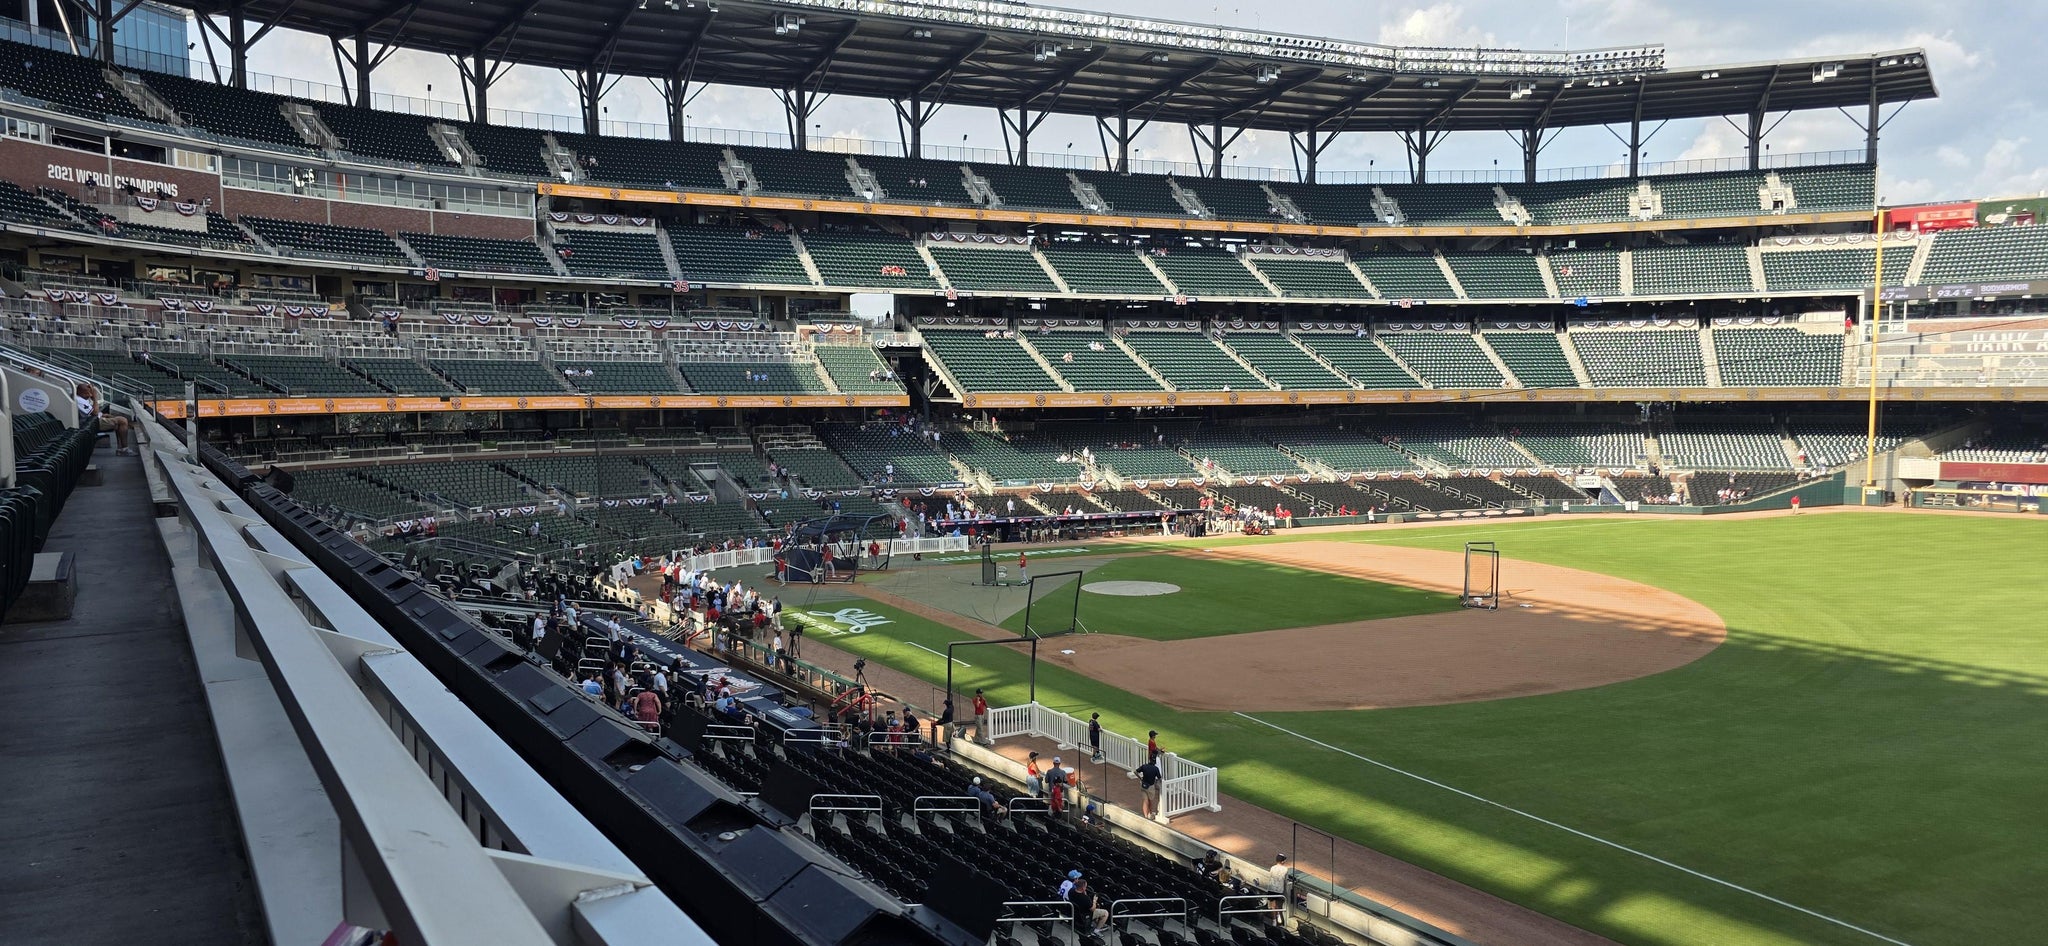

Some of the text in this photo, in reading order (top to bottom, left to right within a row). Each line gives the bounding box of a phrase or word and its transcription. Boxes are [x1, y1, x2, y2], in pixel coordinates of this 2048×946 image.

[47, 164, 74, 181] 2021
[425, 267, 440, 281] 31
[673, 280, 690, 292] 35
[1966, 332, 2029, 352] HANK
